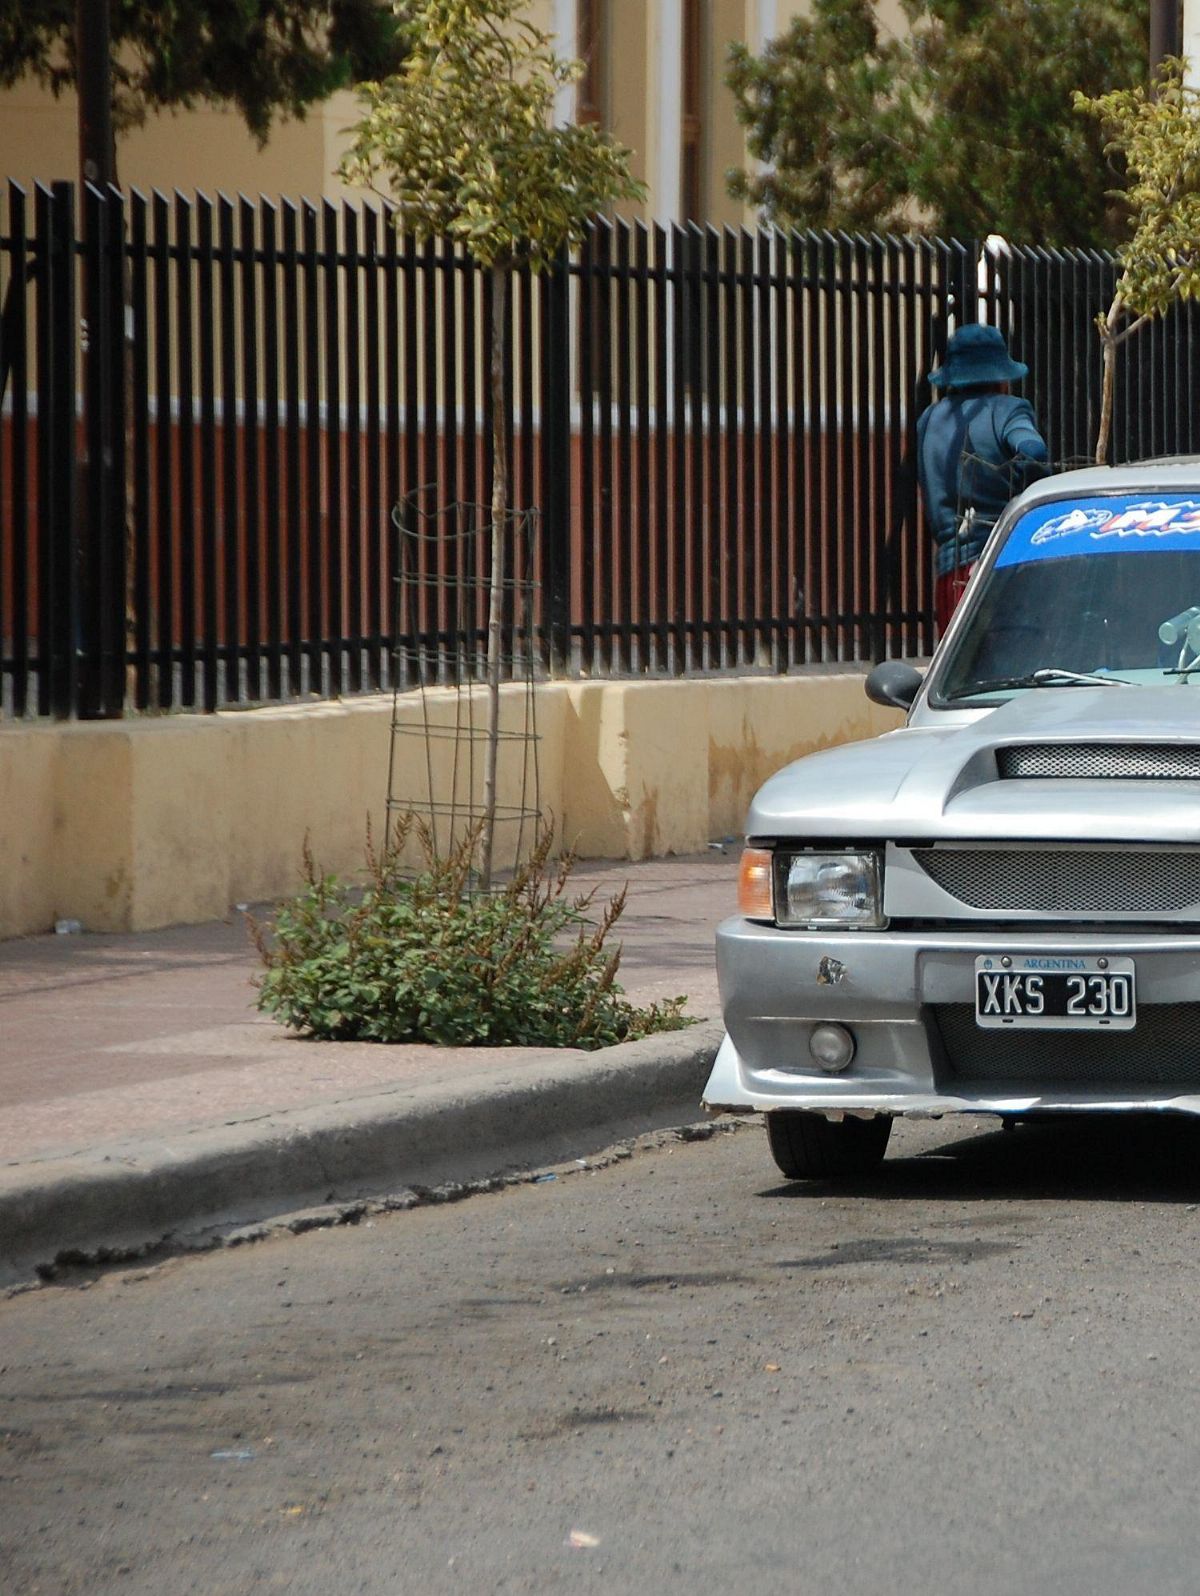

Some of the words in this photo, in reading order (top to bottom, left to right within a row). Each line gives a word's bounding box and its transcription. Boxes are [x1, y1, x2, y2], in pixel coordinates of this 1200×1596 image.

[1023, 958, 1086, 969] ARGENTINA
[983, 974, 1045, 1014] XKS
[1066, 974, 1129, 1015] 230
